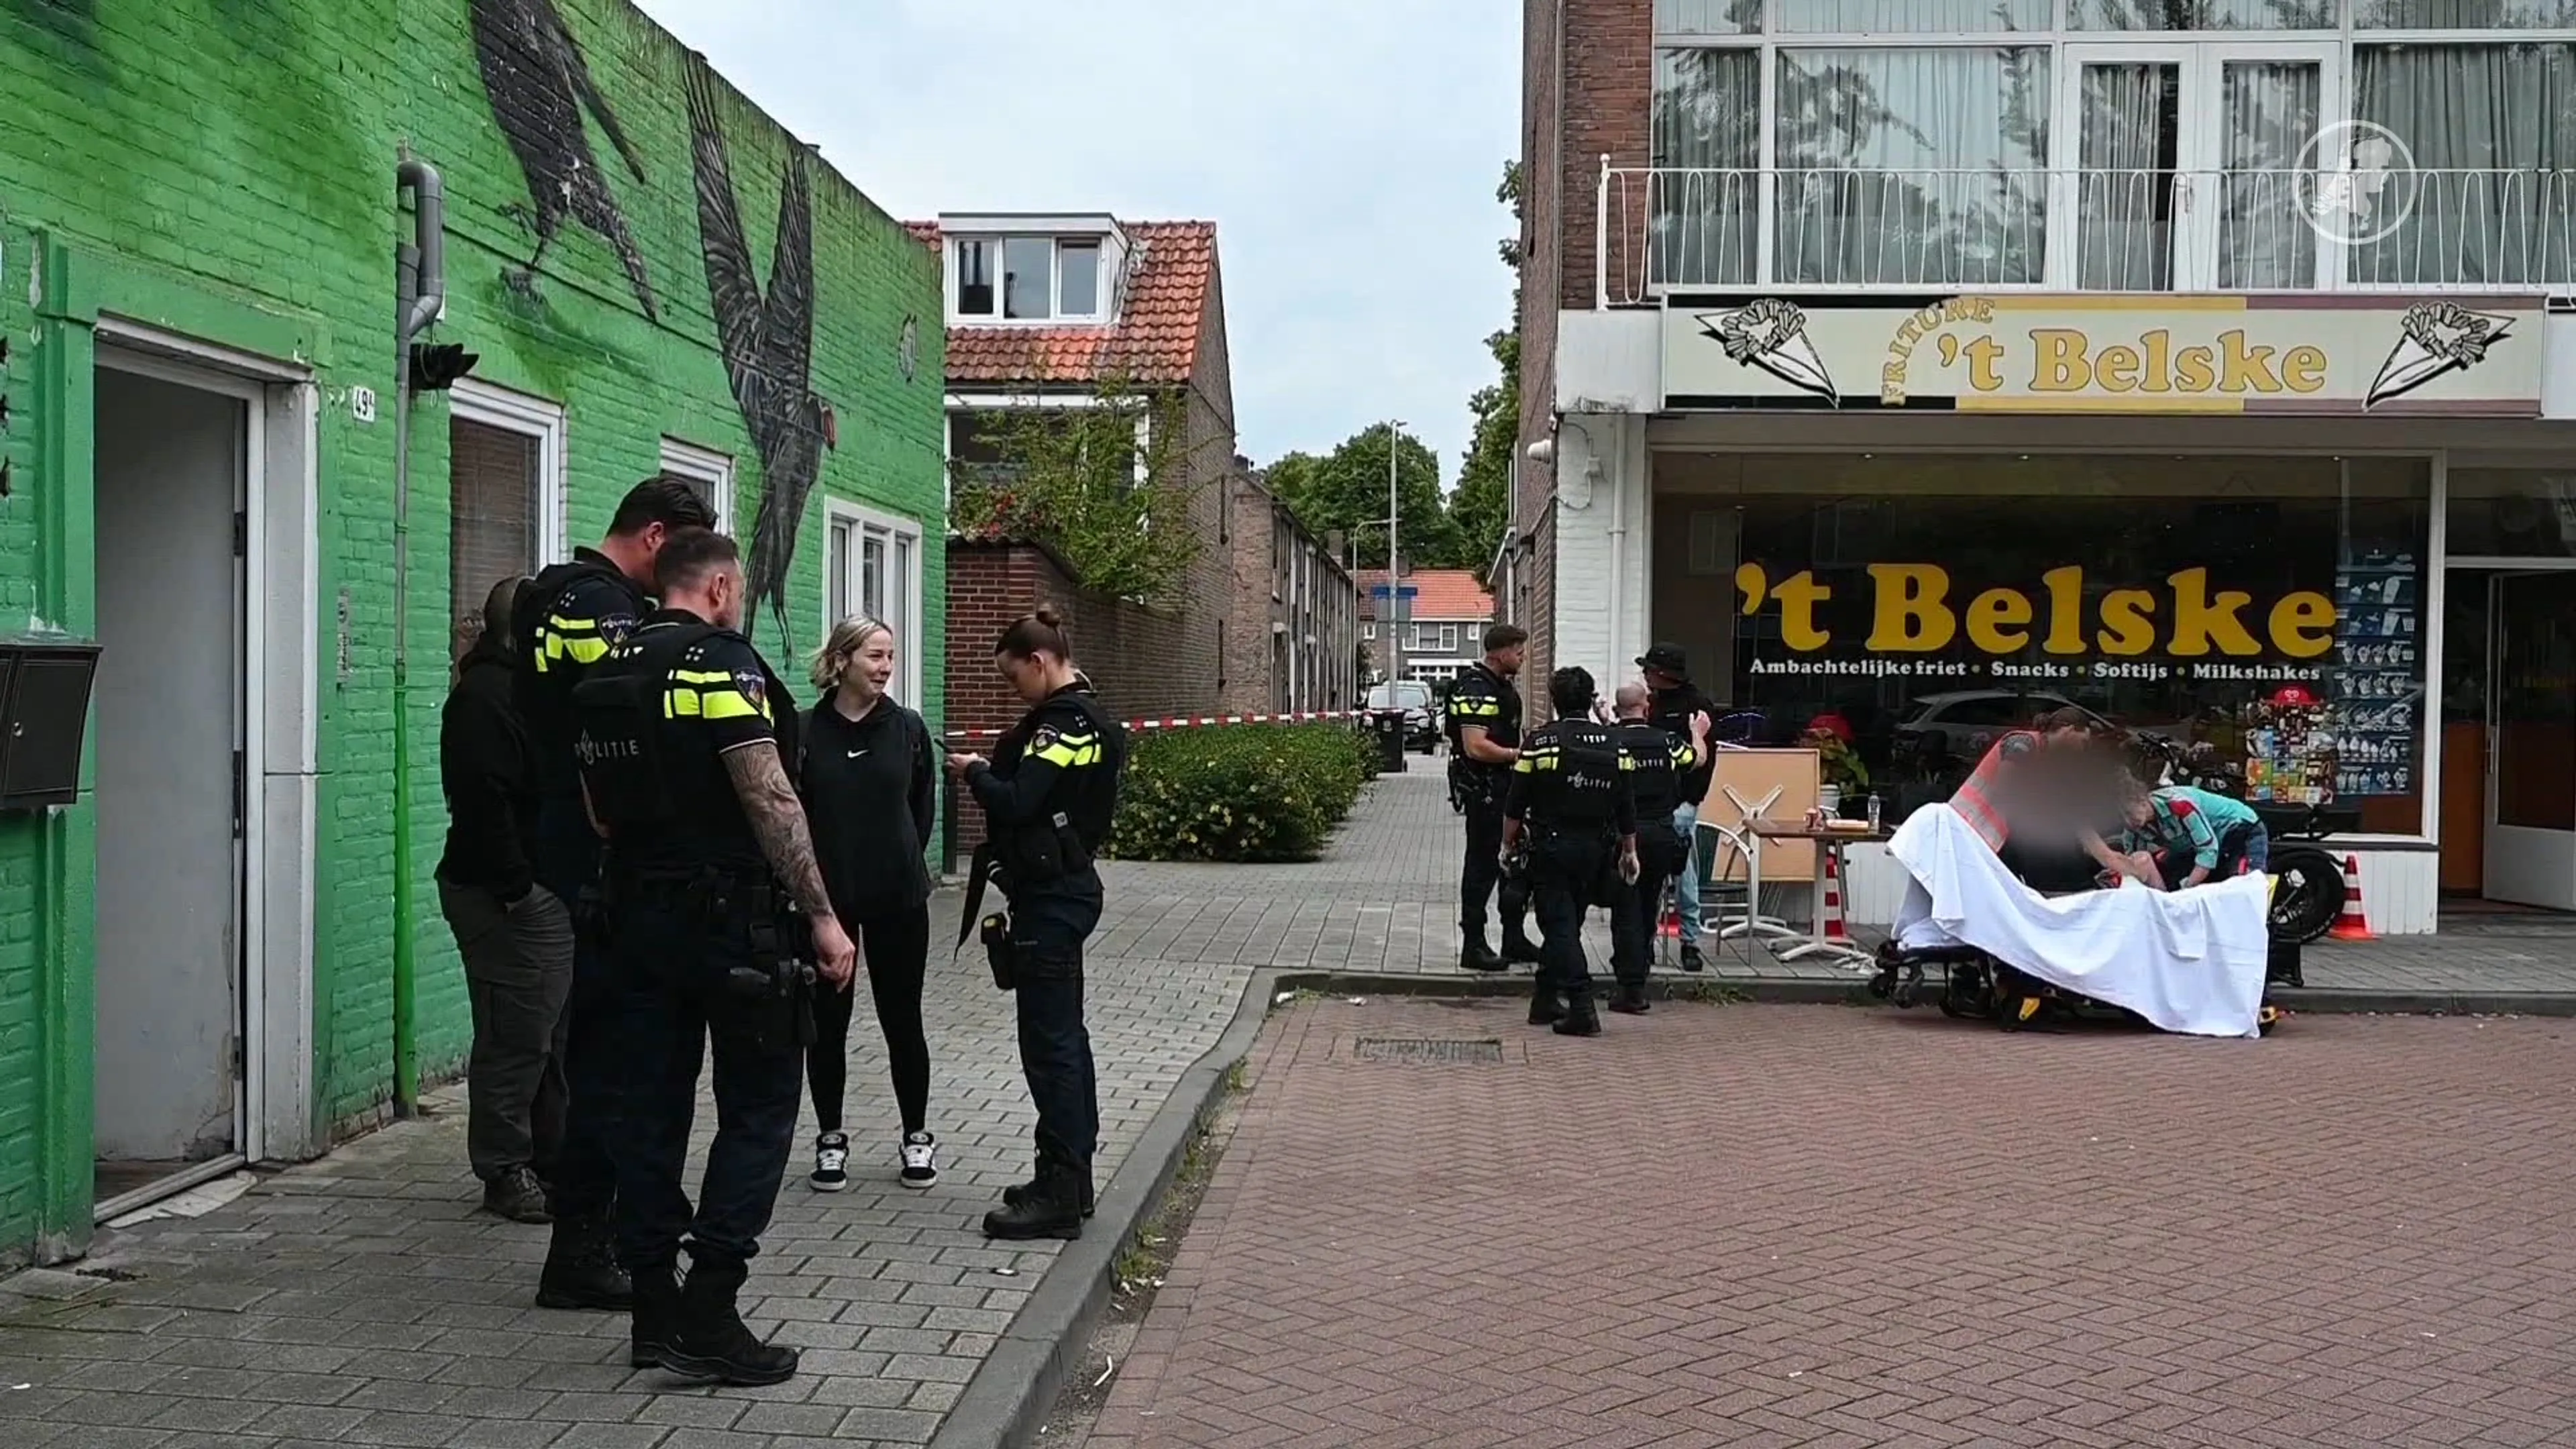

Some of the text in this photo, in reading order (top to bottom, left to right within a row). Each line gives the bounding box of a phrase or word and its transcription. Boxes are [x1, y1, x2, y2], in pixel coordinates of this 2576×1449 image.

[1880, 297, 1996, 407] FRITURE
[2028, 329, 2328, 392] Belske
[1864, 563, 2337, 658] Belske
[1750, 657, 2321, 682] Ambachtelijke friet Snacks Softijs Milkshakes
